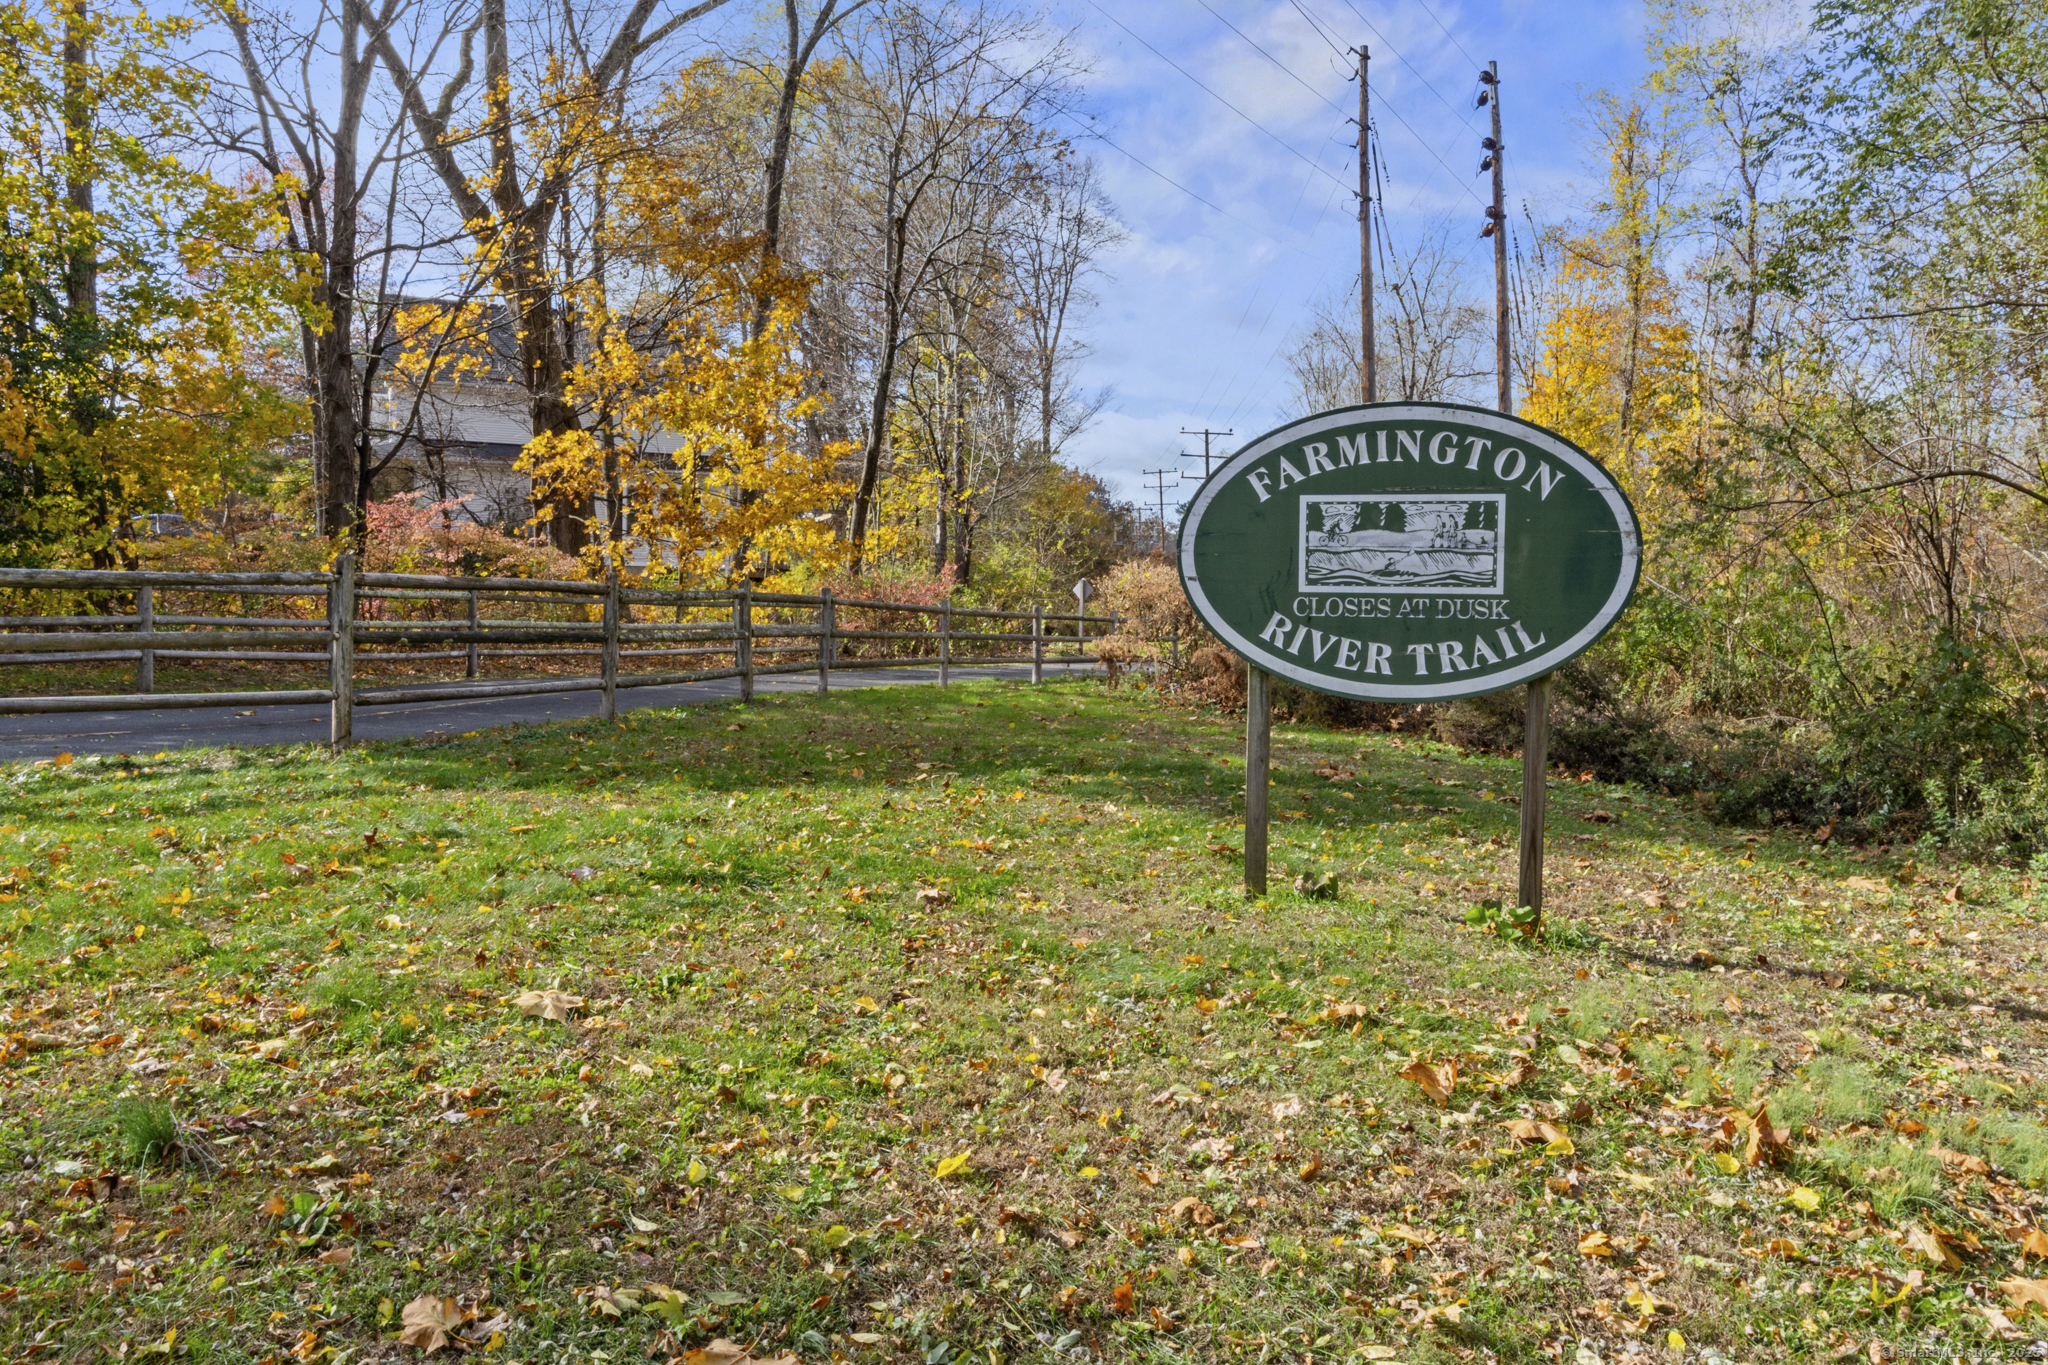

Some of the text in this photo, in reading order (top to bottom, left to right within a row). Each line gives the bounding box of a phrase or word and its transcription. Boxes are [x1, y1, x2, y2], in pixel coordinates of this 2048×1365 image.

[1245, 429, 1566, 503] FARMINGTON
[1292, 596, 1511, 620] CLOSES AT DUSK
[1258, 610, 1546, 676] RIVER TRAIL
